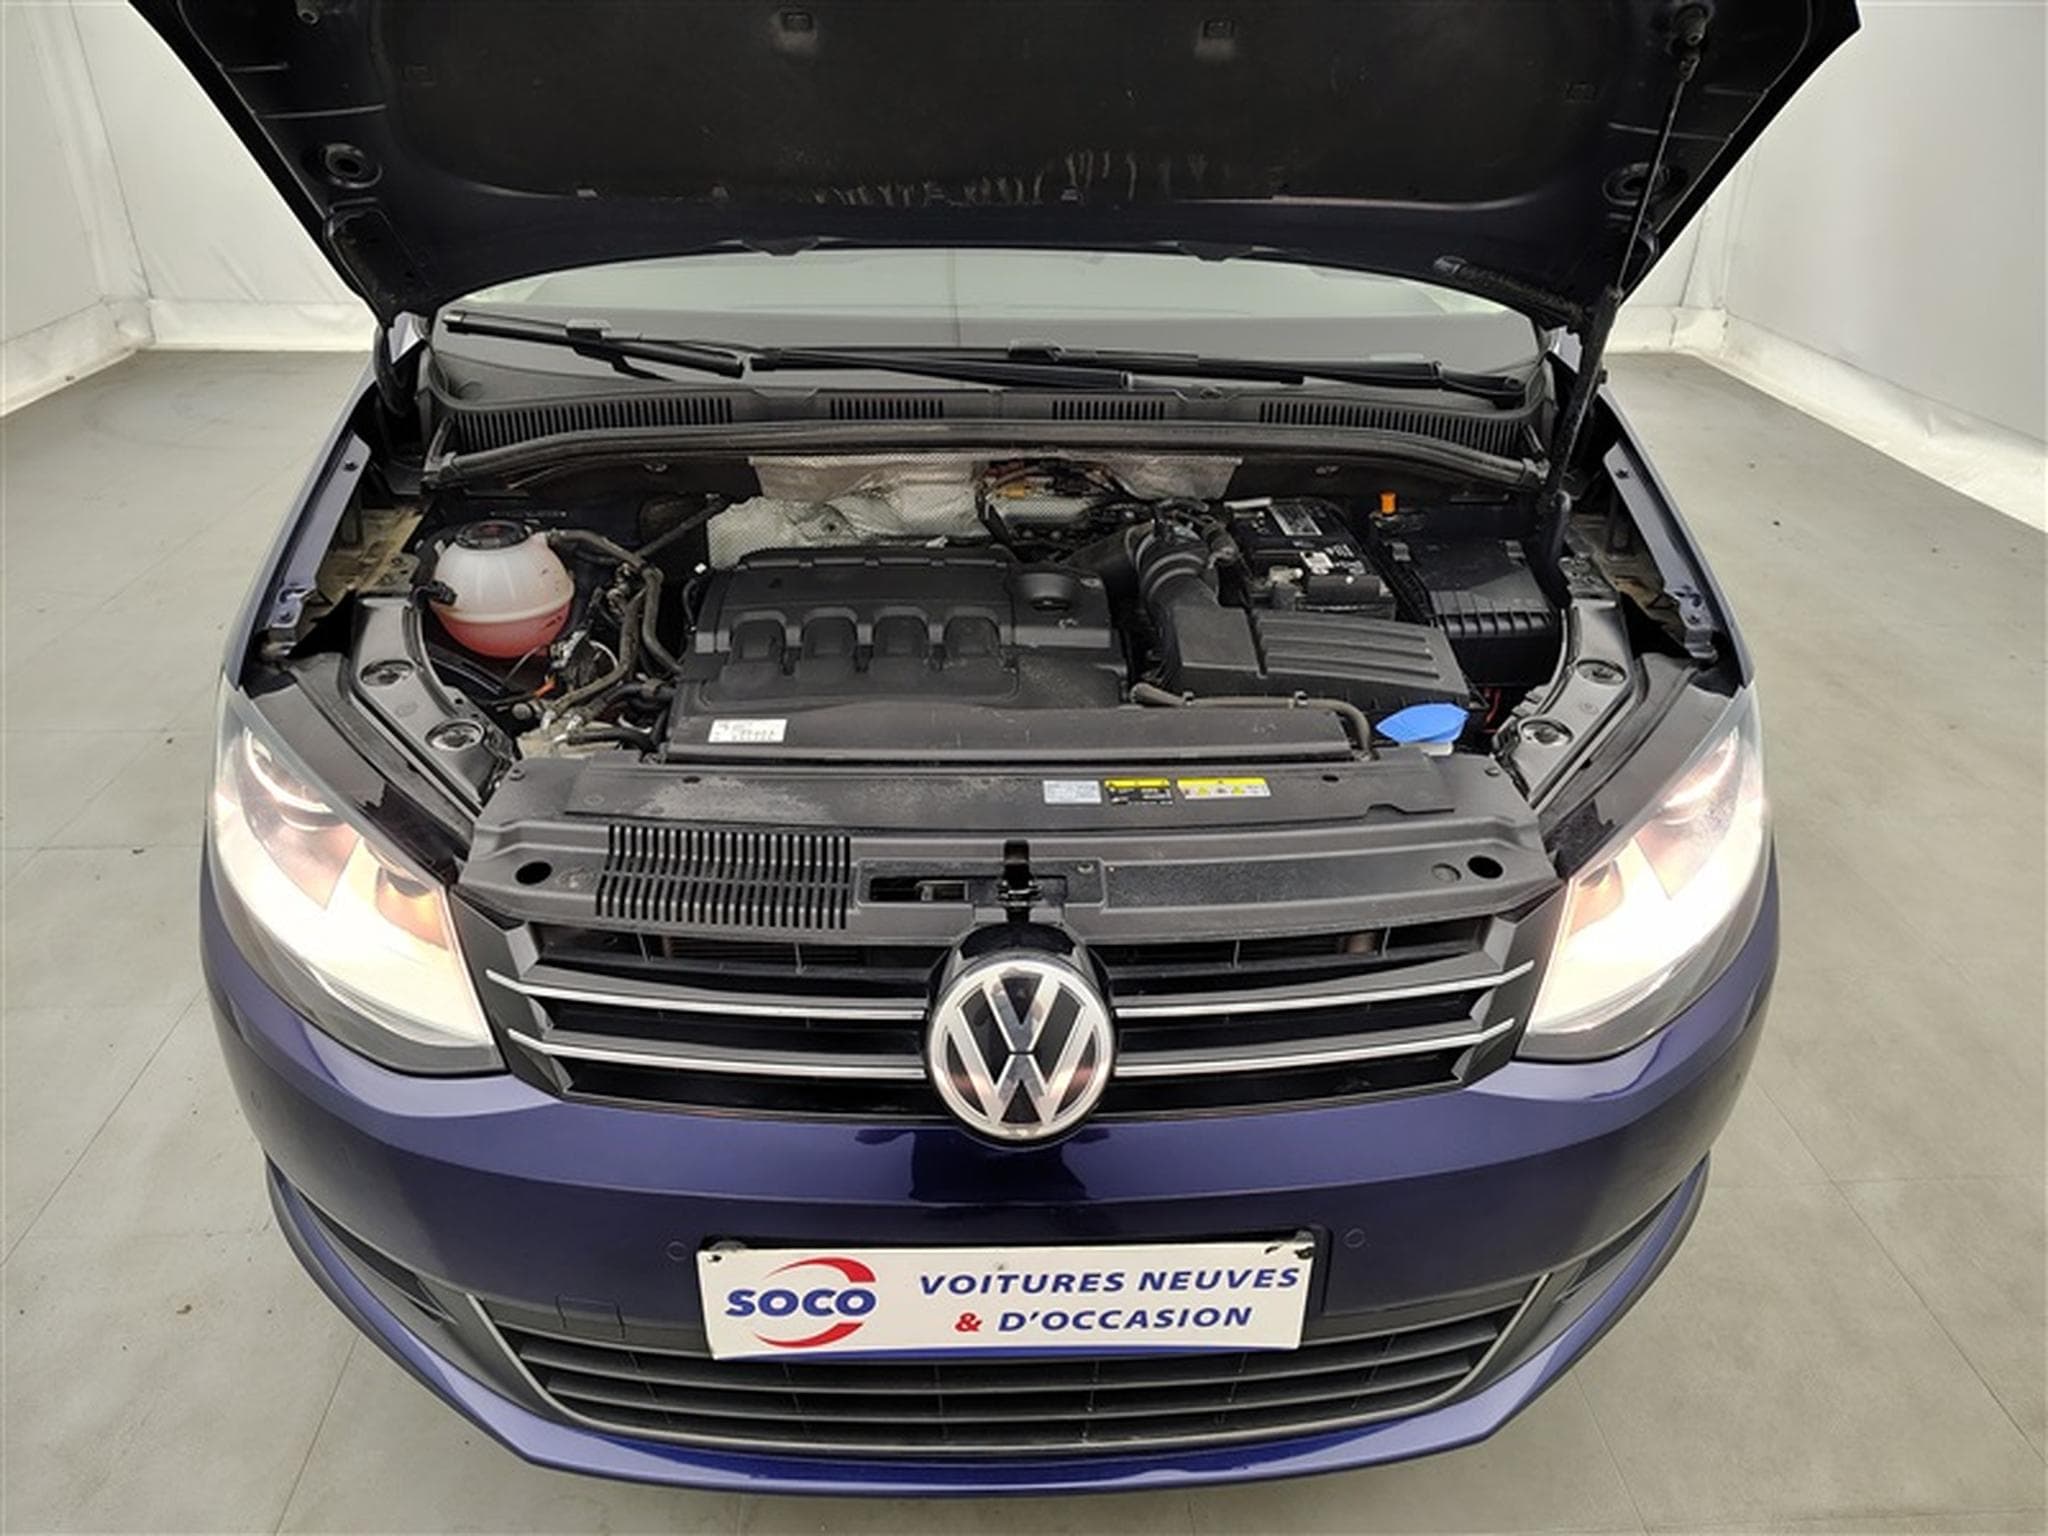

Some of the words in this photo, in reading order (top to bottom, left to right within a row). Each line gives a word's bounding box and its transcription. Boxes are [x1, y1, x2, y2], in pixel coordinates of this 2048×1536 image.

[920, 1272, 1125, 1295] VOITURES
[1139, 1267, 1300, 1292] NEUVES
[725, 1288, 877, 1317] SOCO
[955, 1312, 982, 1333] &
[998, 1306, 1253, 1333] D'OCCASION
